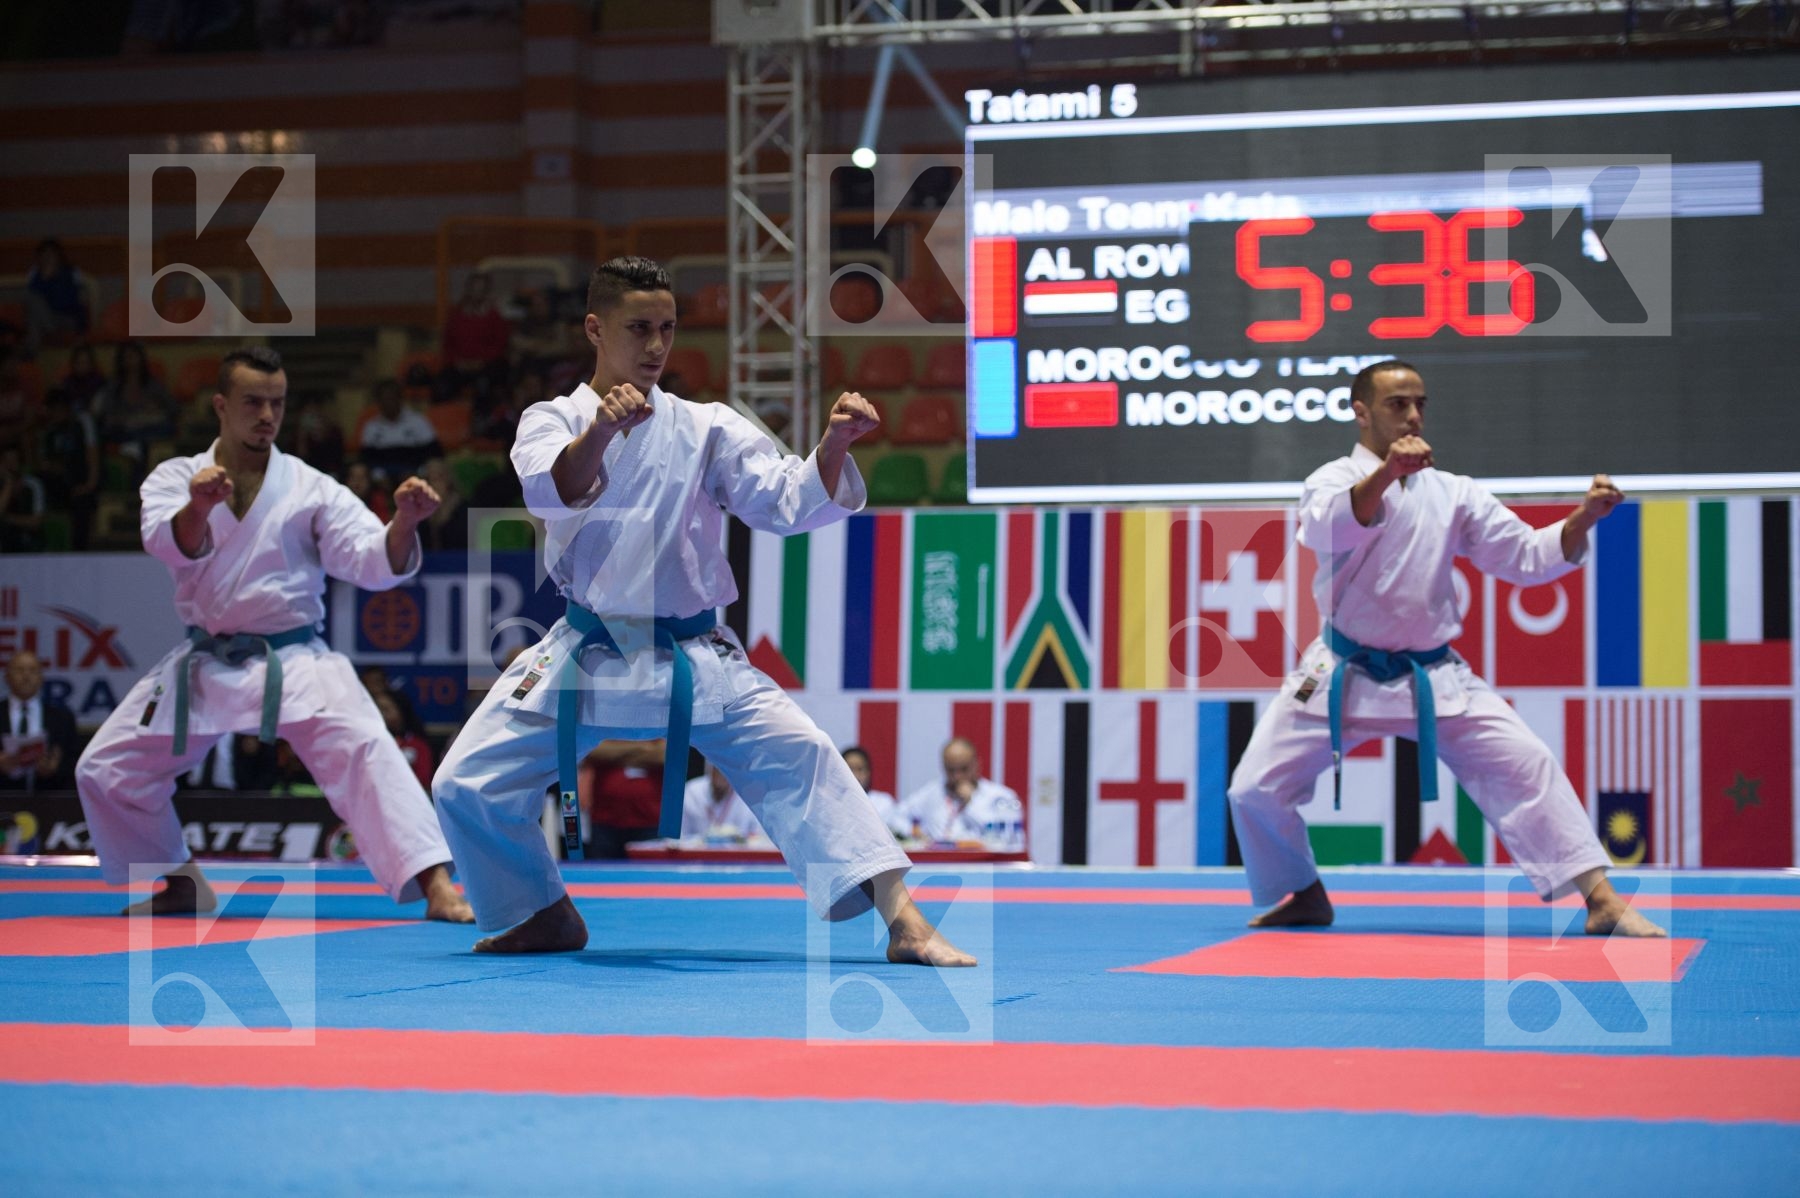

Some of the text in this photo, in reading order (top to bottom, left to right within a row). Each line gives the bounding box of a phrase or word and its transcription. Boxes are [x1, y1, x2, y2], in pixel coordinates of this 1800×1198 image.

[965, 83, 1138, 124] Tatami 5
[973, 190, 1301, 235] Male Team Kata
[1025, 247, 1086, 282] AL
[1235, 206, 1536, 343] 5:36
[1125, 387, 1354, 426] MOROCCO
